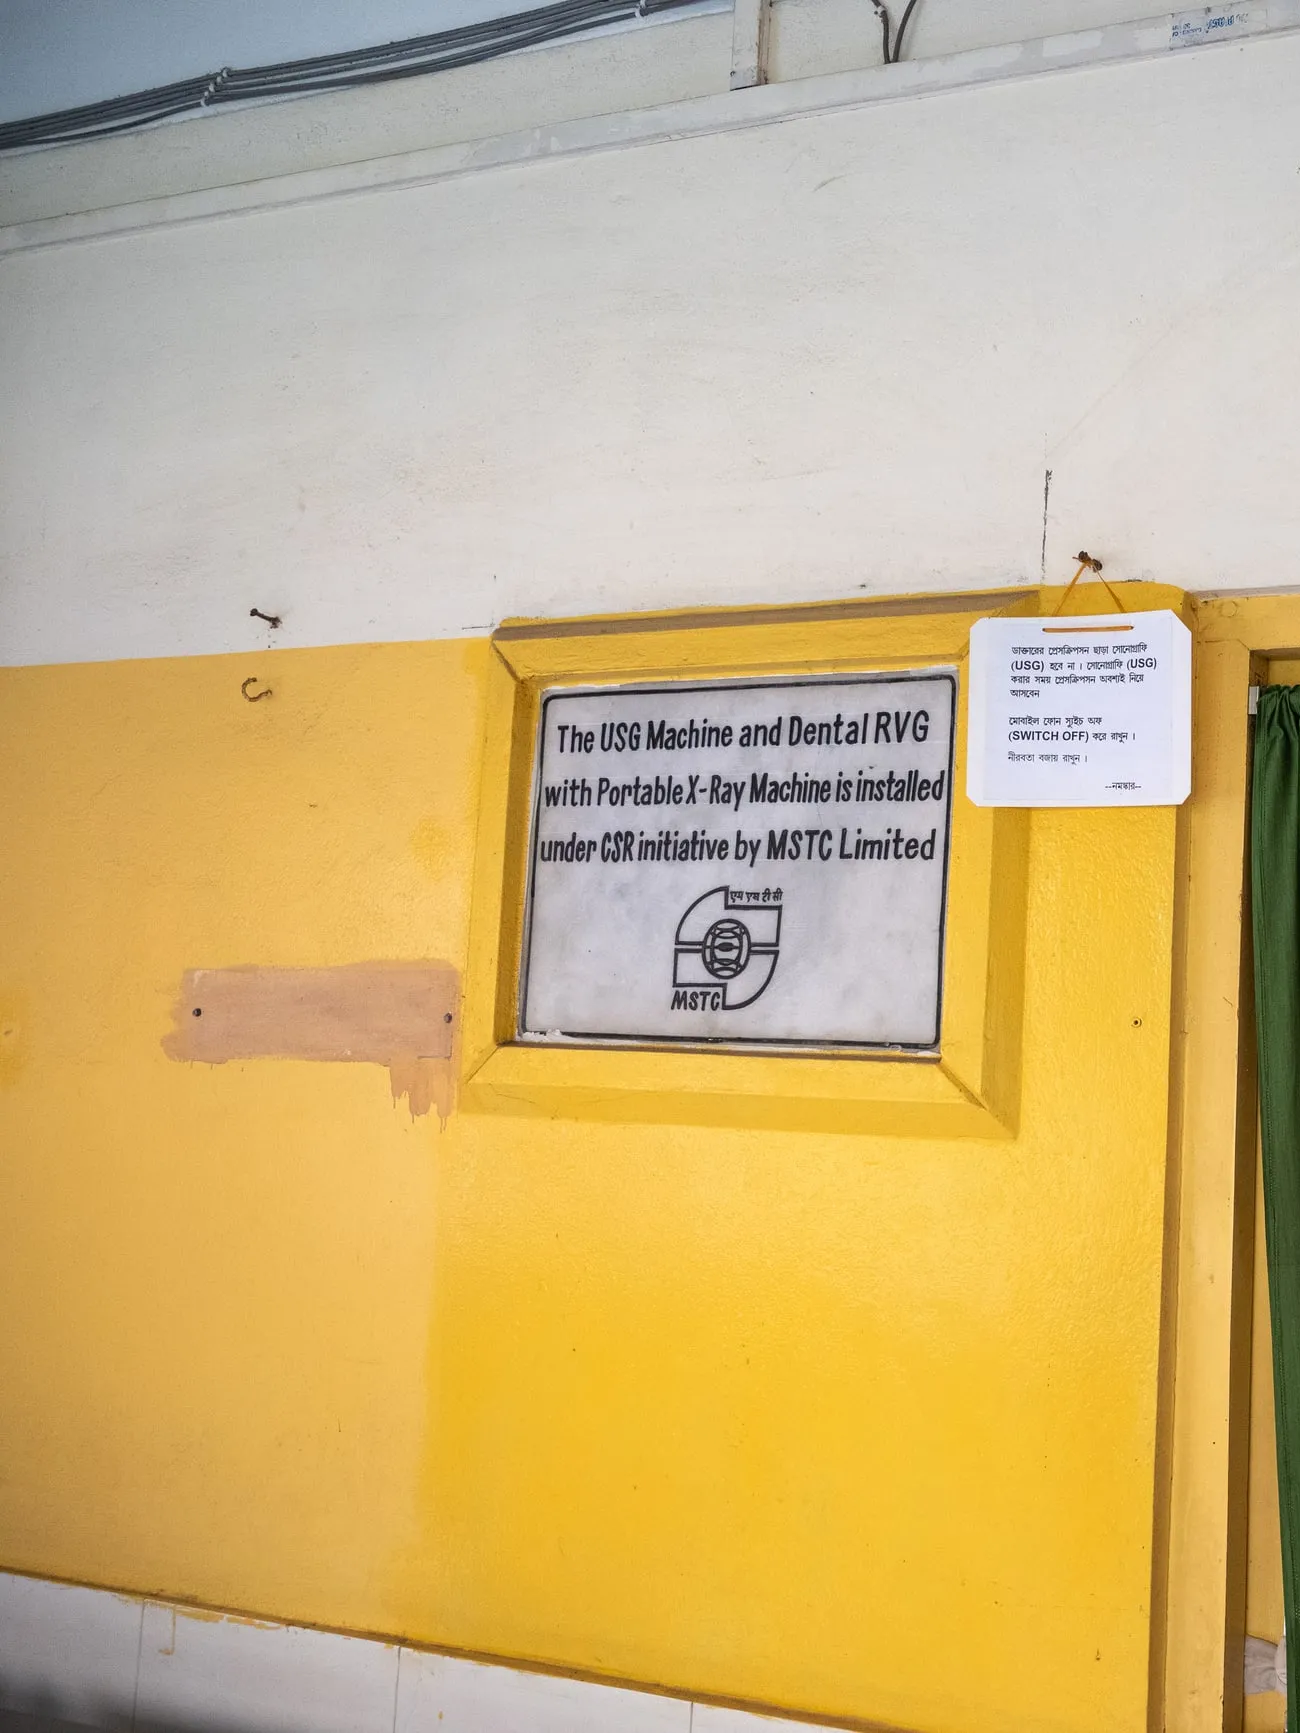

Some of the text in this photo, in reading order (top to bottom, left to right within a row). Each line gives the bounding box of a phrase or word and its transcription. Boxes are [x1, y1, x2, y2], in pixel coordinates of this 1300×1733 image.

[1011, 660, 1045, 672] (USG)
[1049, 662, 1063, 672] হবে
[1067, 663, 1076, 671] না
[1126, 657, 1157, 670] (USG)
[1011, 676, 1031, 685] করার
[1010, 689, 1040, 698] আসবেন
[1043, 716, 1061, 726] ফোন
[557, 709, 930, 754] The USG Machine and Dental RVG
[1008, 730, 1059, 742] (SWITCH
[1062, 730, 1089, 743] OFF)
[544, 769, 946, 812] with Portable X-Ray Machine is installed
[540, 827, 937, 868] under CSR initiative by MSTC Limited
[670, 990, 721, 1012] MSTC
